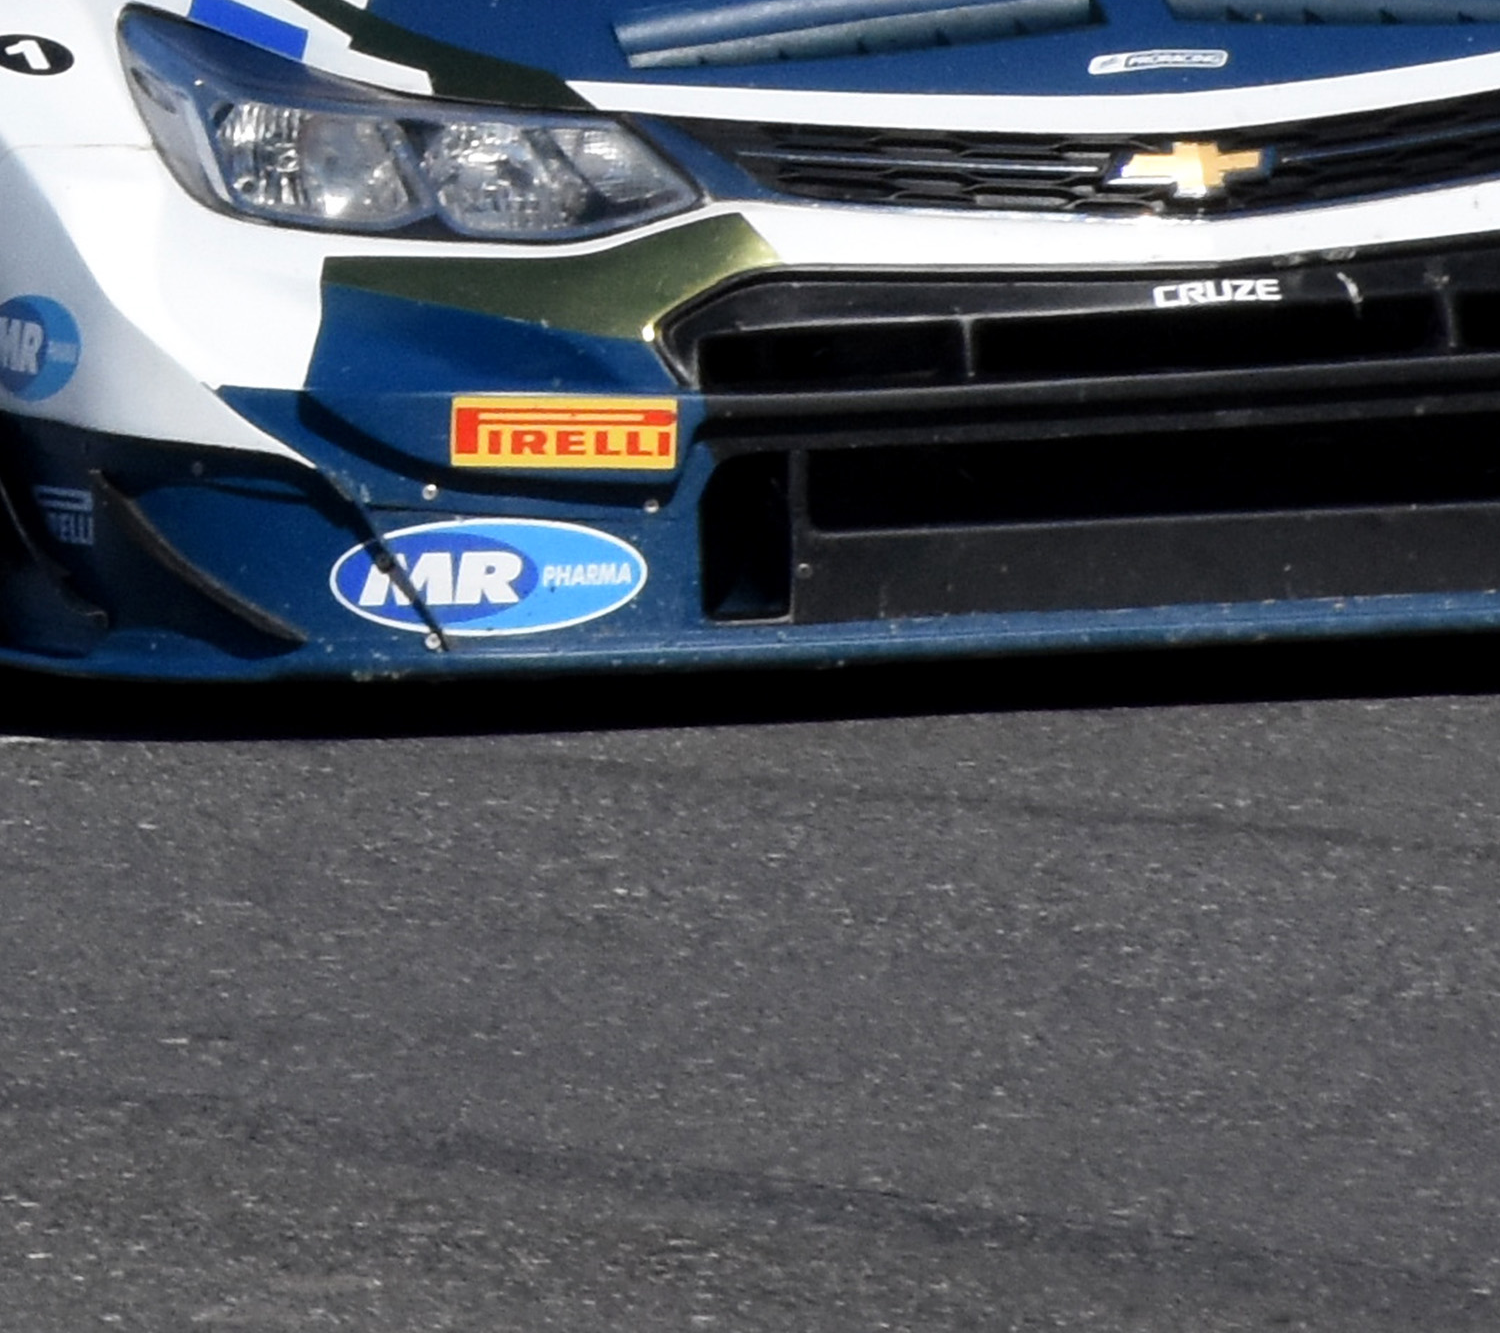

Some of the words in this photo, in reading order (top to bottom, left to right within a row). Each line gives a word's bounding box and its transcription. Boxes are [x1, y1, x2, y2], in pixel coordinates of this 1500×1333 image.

[5, 39, 51, 70] 1
[1152, 278, 1283, 308] CRUZE
[456, 407, 677, 456] PIRELLI
[358, 551, 524, 607] MR
[542, 563, 633, 589] PHARMA
